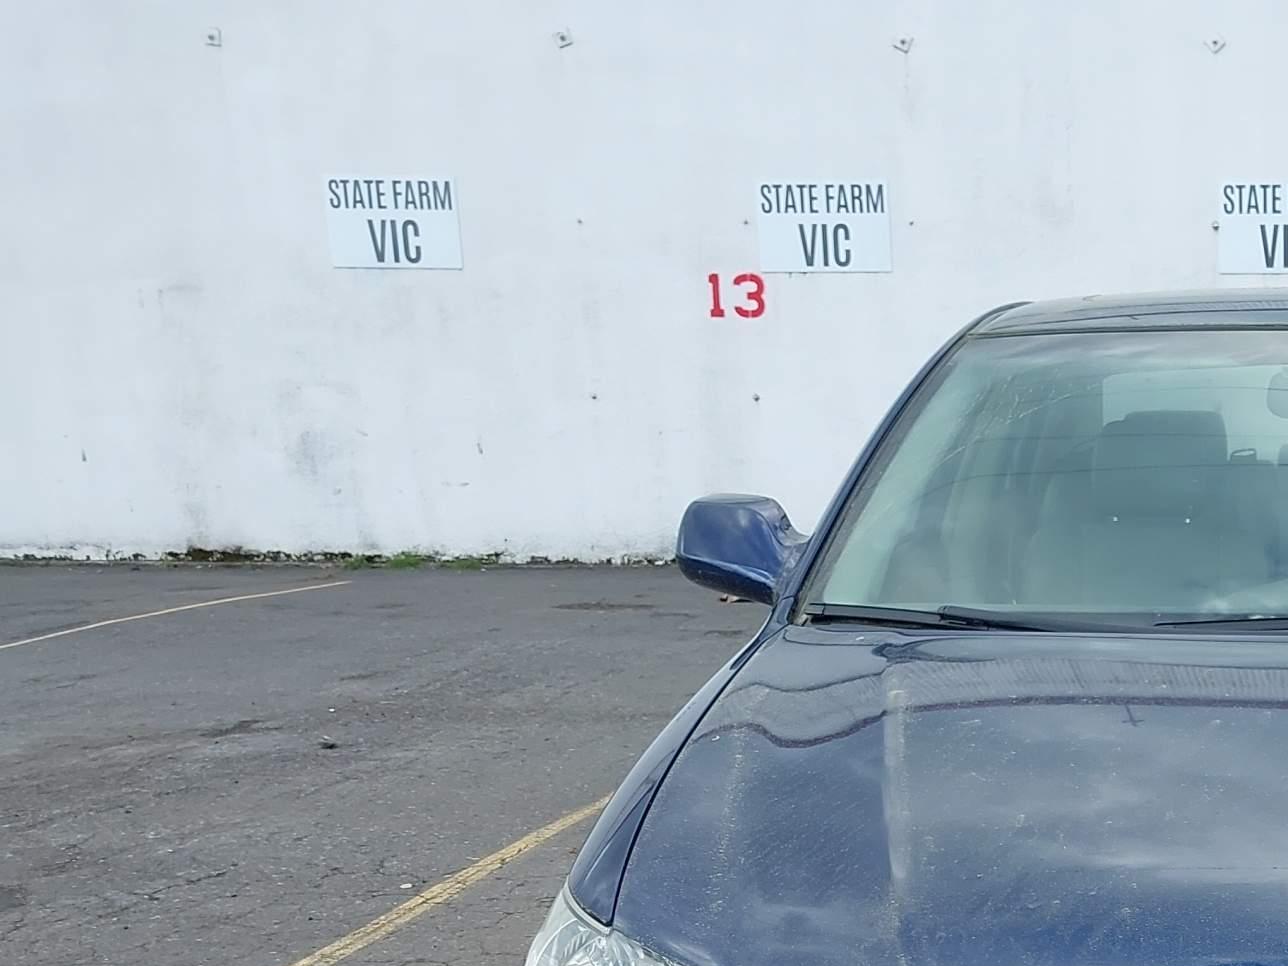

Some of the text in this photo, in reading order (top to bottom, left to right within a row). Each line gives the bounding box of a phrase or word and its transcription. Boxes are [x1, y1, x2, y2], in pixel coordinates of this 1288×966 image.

[328, 179, 453, 210] STATE FARM
[760, 184, 885, 214] STATE FARM
[1223, 184, 1282, 215] STATE
[367, 219, 422, 264] VIC
[798, 223, 852, 267] VIC
[708, 273, 766, 318] 13
